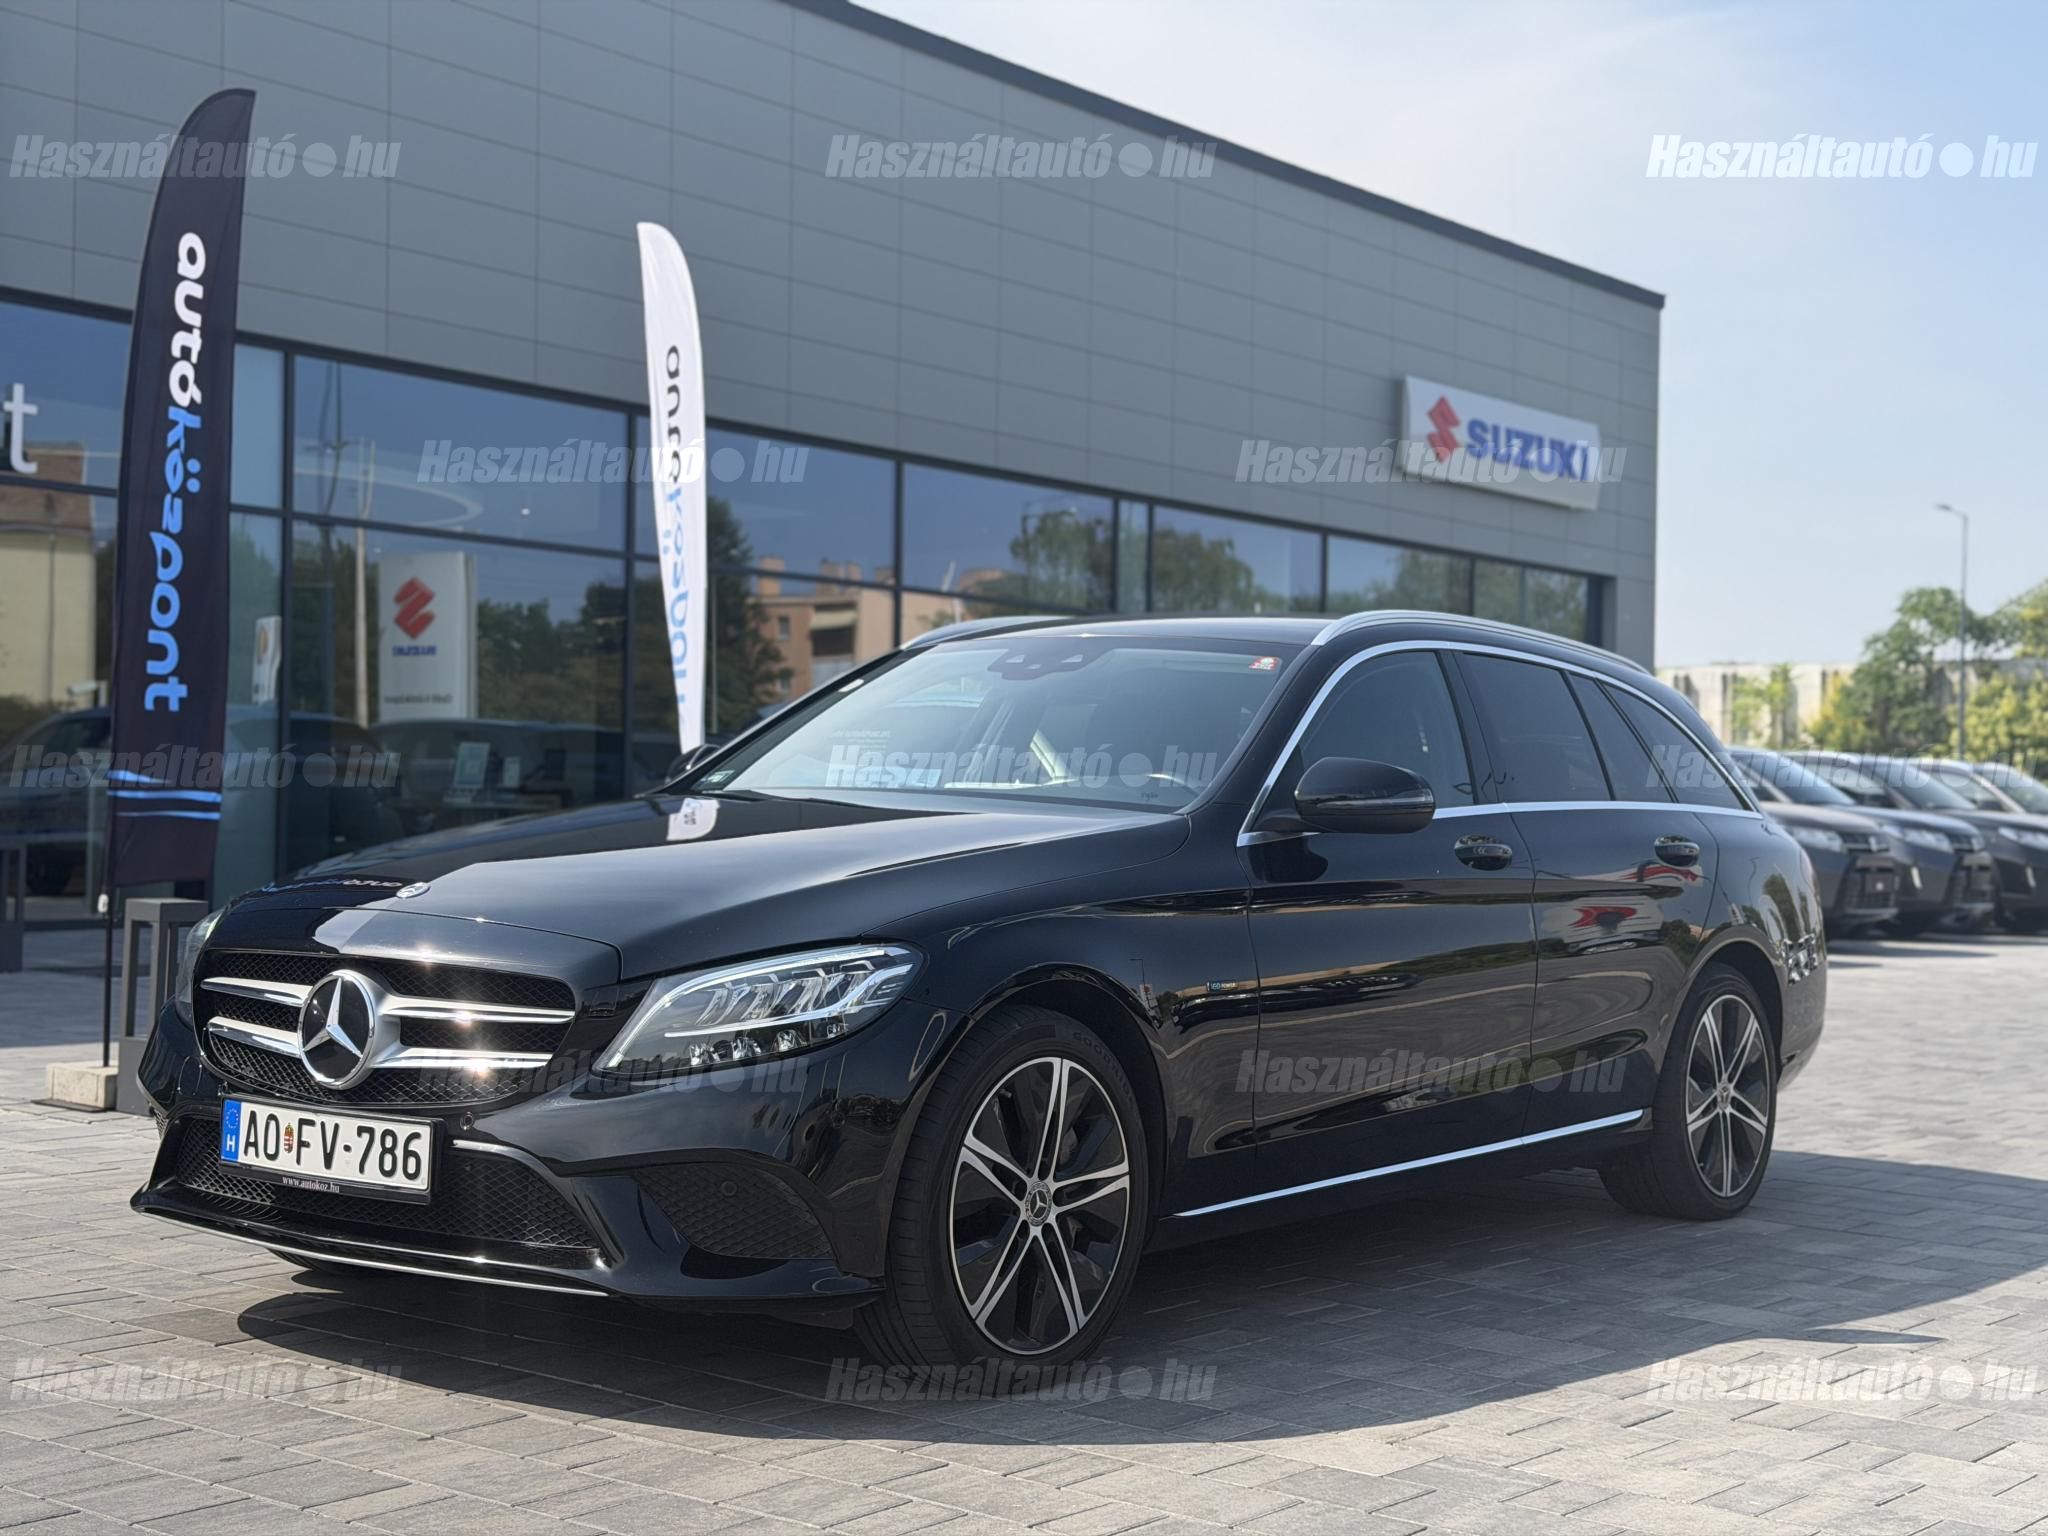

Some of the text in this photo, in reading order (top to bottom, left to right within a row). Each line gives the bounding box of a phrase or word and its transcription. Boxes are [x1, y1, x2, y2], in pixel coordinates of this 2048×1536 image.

[144, 232, 206, 712] autóközpont
[1466, 418, 1591, 482] SUZUKI
[226, 1135, 236, 1152] H
